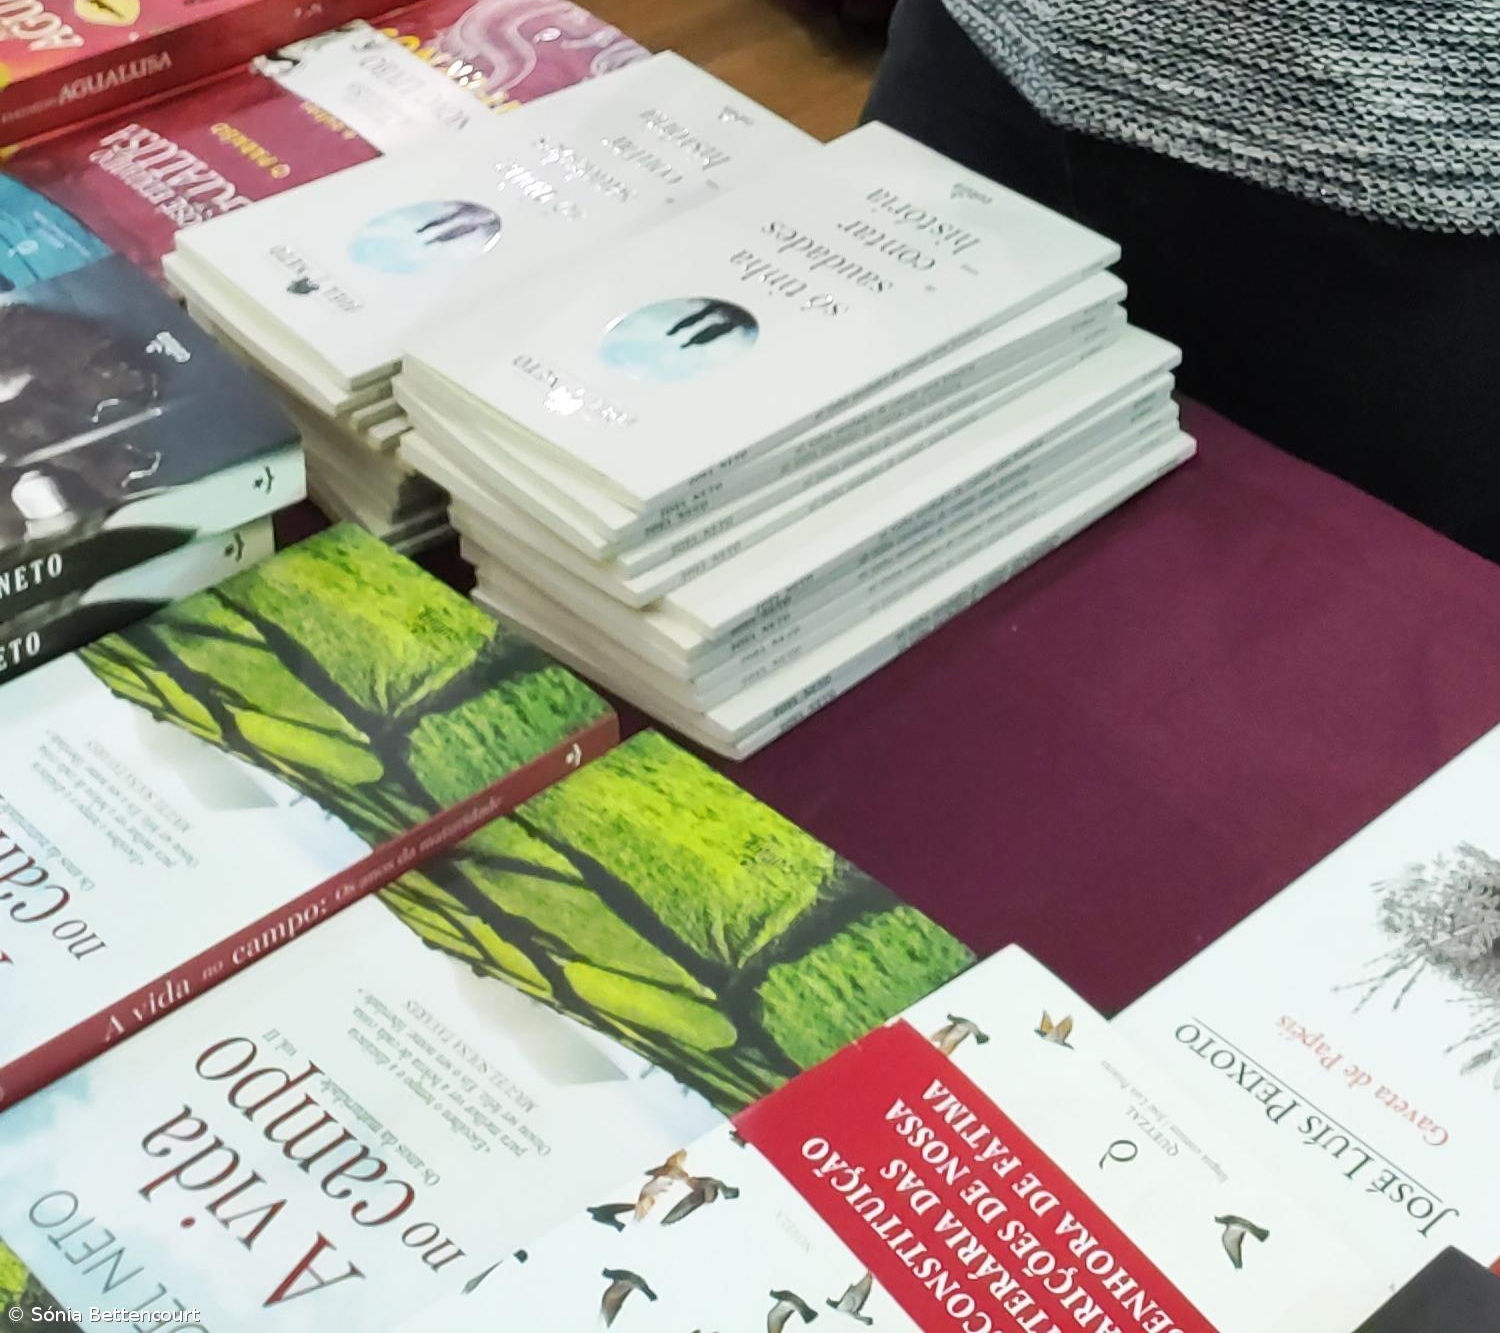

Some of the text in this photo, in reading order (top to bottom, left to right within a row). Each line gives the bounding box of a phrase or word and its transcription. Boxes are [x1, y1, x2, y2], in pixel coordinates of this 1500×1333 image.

[762, 222, 893, 293] saudades
[838, 221, 936, 270] contar
[866, 189, 980, 255] história
[730, 250, 847, 317] só tinha
[52, 918, 107, 961] no
[101, 1010, 122, 1043] A
[132, 971, 189, 1024] vida
[202, 958, 223, 982] no
[233, 898, 329, 966] campo:
[317, 1075, 442, 1187] Os anos da maturidade
[1175, 1024, 1459, 1237] JOSÉ LUÍS PEIXOTO
[1276, 1014, 1449, 1148] Gaveta de Papéis
[138, 1103, 365, 1309] A vida
[195, 1036, 468, 1273] no campo
[880, 1158, 942, 1216] DAS
[885, 1097, 972, 1187] NOSSA
[959, 1179, 1009, 1224] DE
[921, 1078, 1184, 1333] FÁTIMA DE ENHORA
[28, 1190, 145, 1294] NETO
[801, 1136, 1004, 1333] CONSTITUIÇÃO
